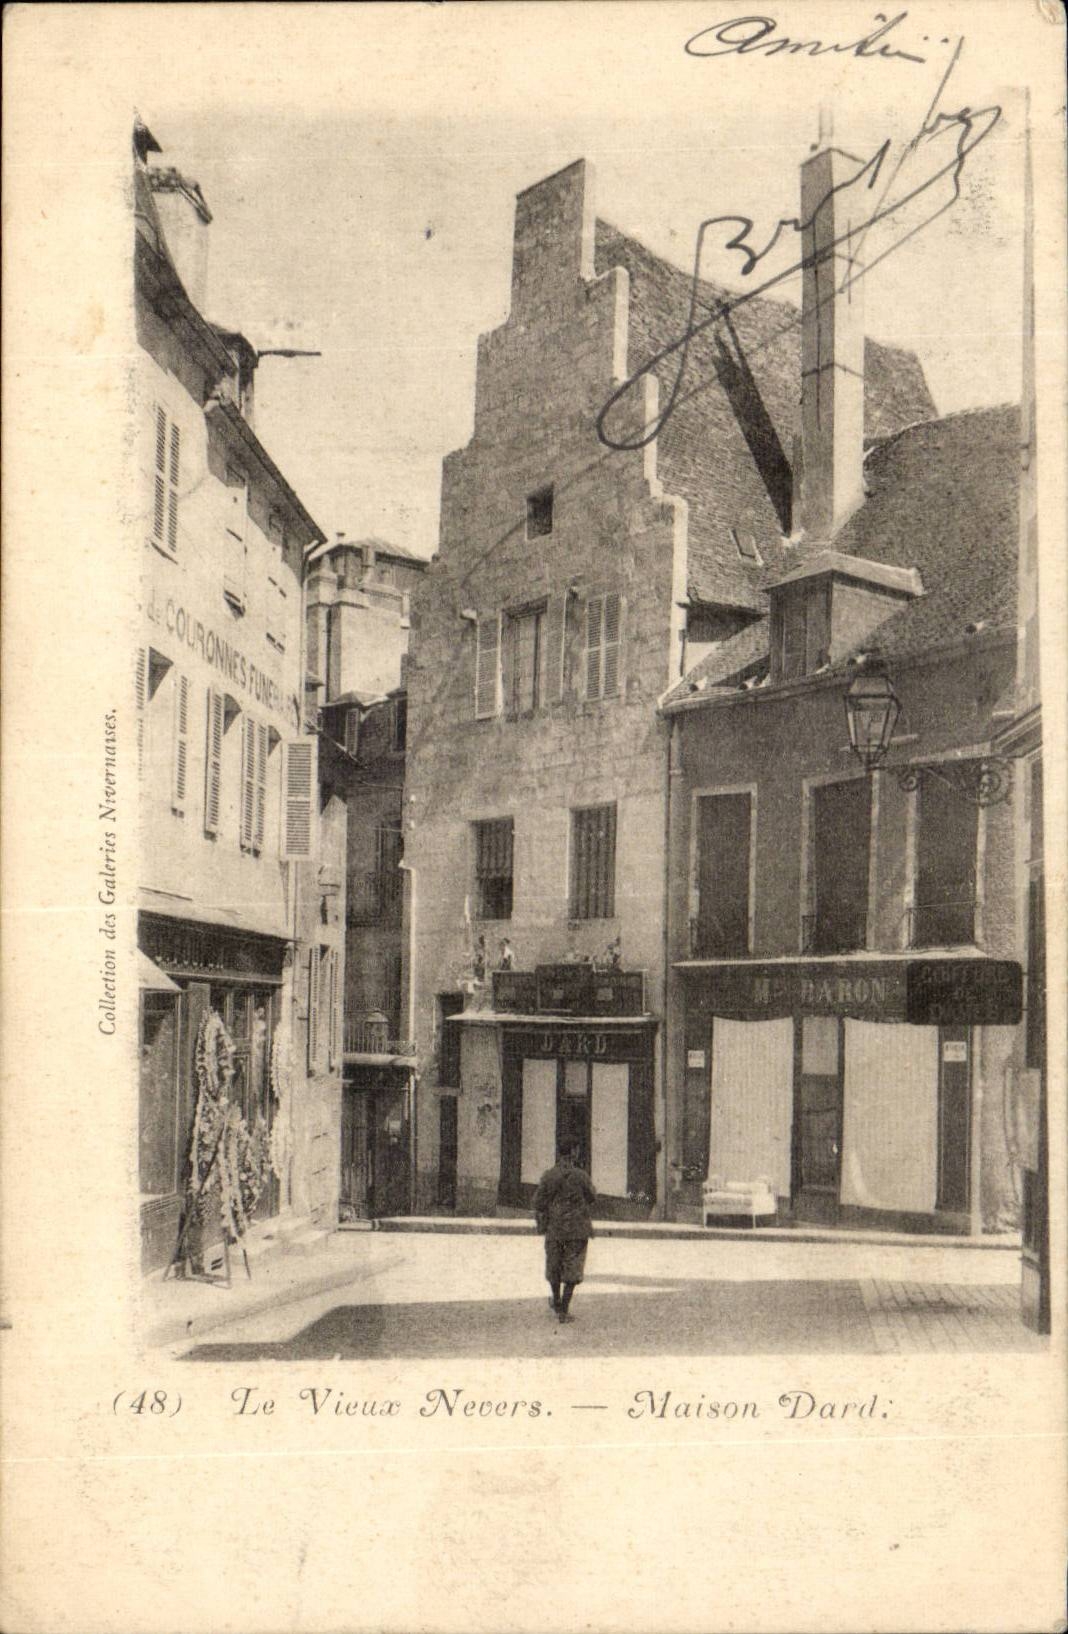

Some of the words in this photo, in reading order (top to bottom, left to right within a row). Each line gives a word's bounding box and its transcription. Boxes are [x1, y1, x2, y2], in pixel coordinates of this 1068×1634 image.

[166, 598, 248, 690] COURONNES
[800, 977, 888, 1004] BARON
[540, 1031, 607, 1055] DARD
